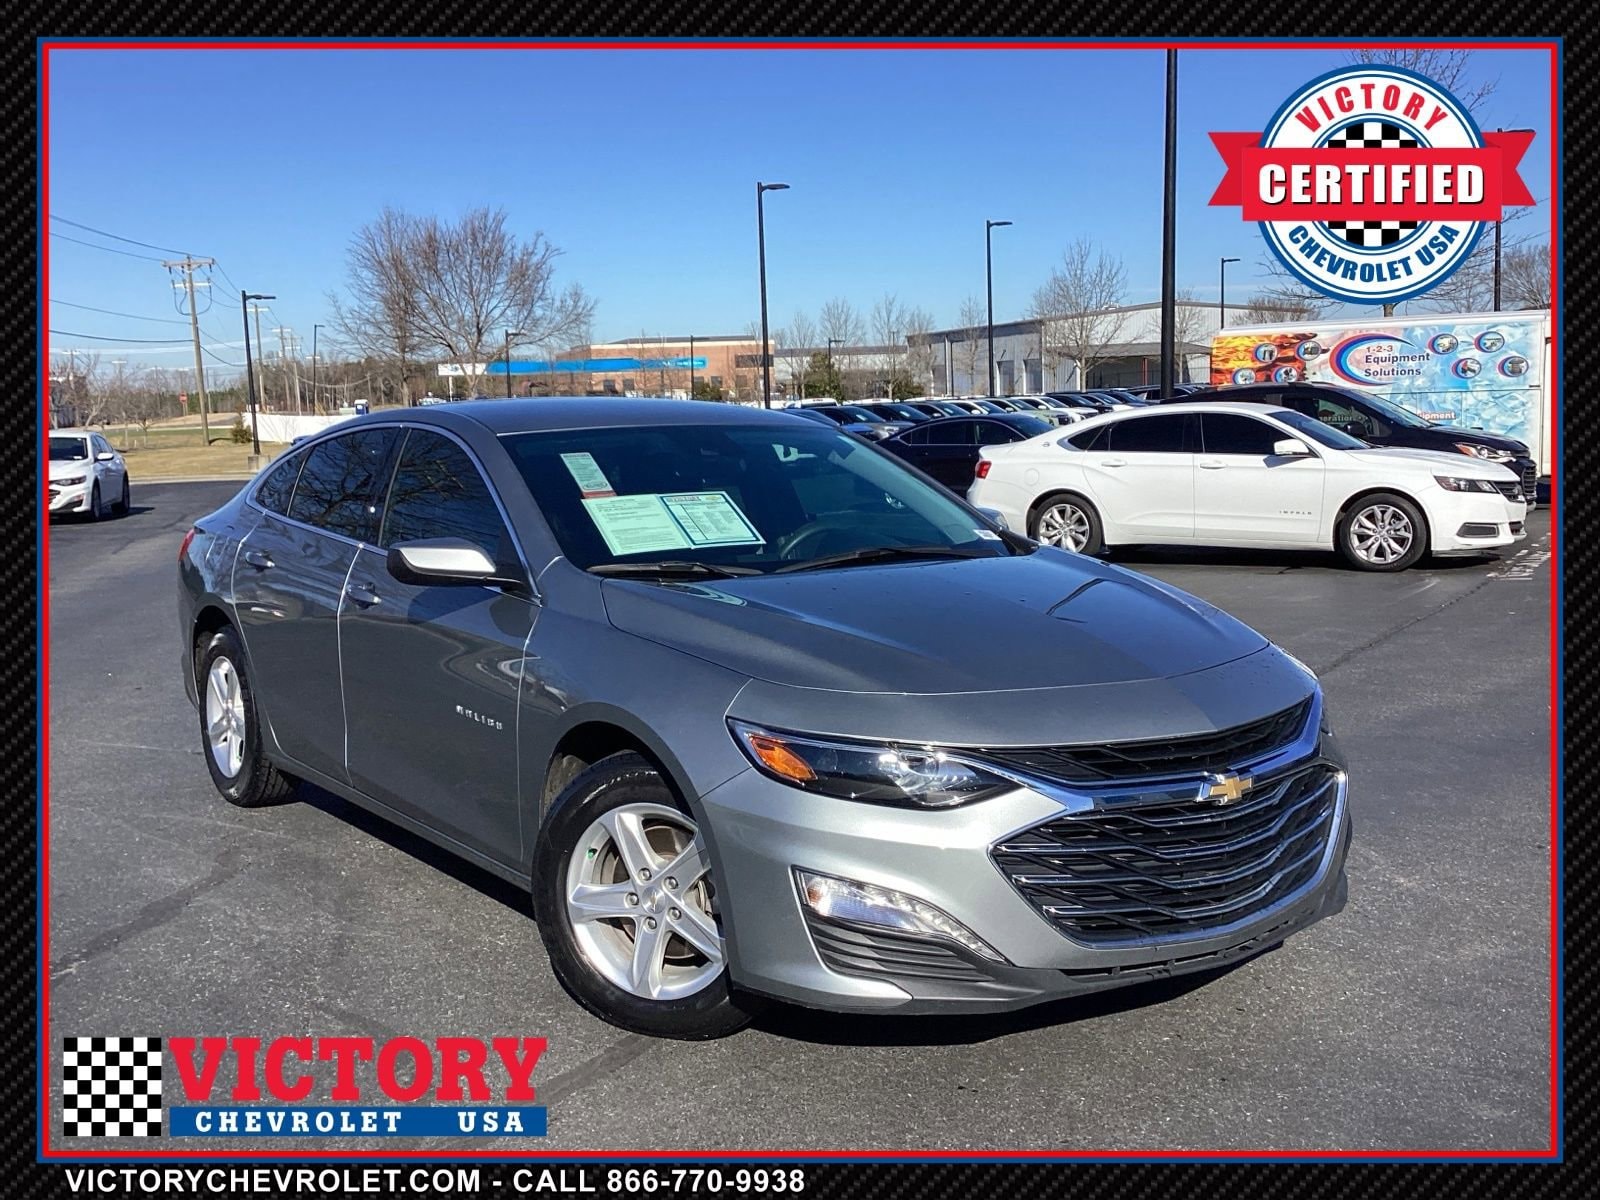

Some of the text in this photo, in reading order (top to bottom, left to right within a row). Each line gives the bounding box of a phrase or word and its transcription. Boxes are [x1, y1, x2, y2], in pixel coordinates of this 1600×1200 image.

[1366, 345, 1394, 353] 1-2-3
[1365, 352, 1431, 365] Equipment
[1364, 367, 1422, 377] Solutions
